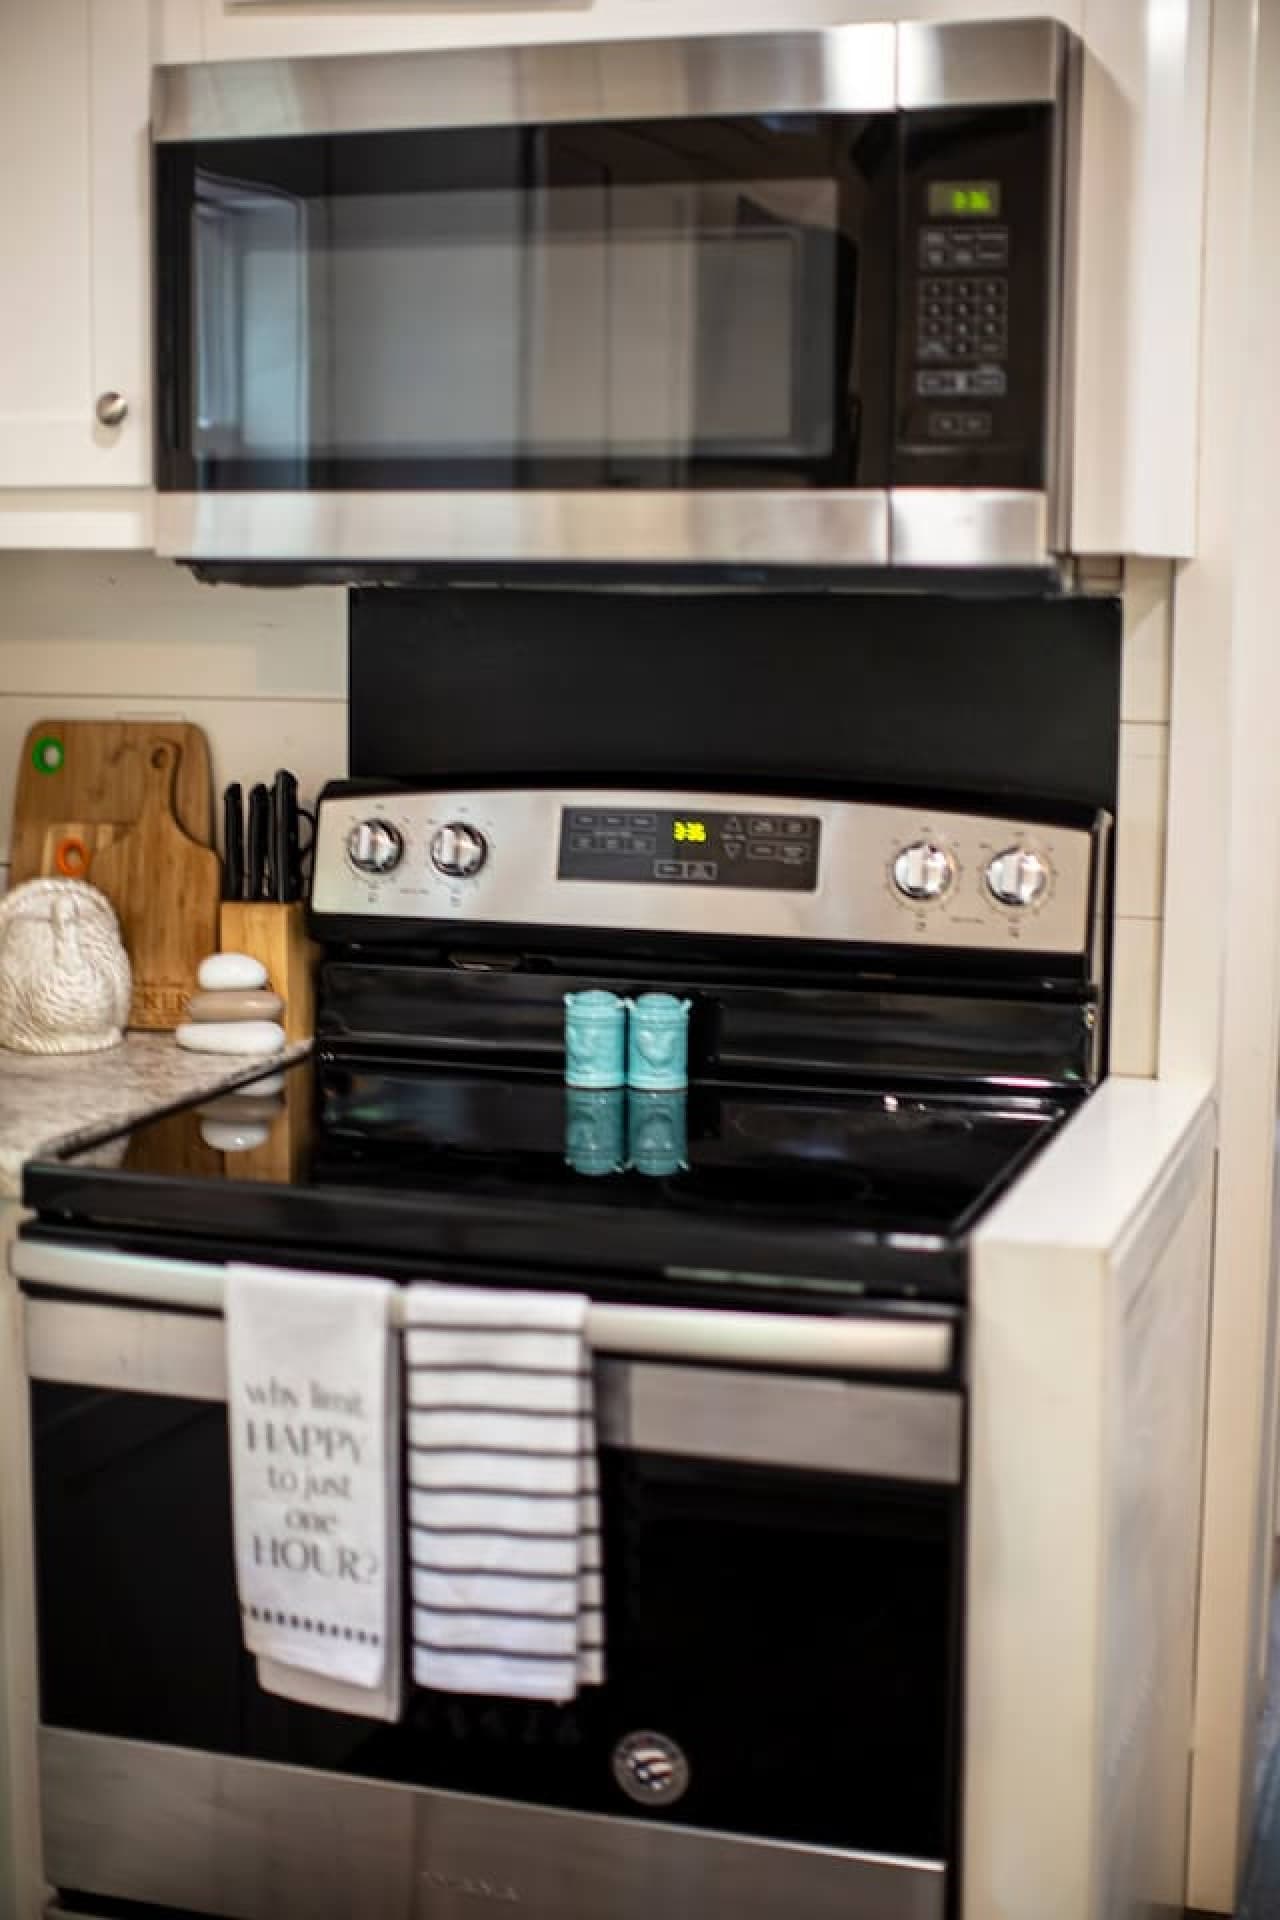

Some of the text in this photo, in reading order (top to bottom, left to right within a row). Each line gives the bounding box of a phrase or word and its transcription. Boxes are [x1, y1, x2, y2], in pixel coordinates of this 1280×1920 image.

[247, 1420, 365, 1463] HAPPY
[267, 1465, 353, 1502] to just
[284, 1508, 339, 1535] one
[254, 1535, 378, 1583] HOUR?
